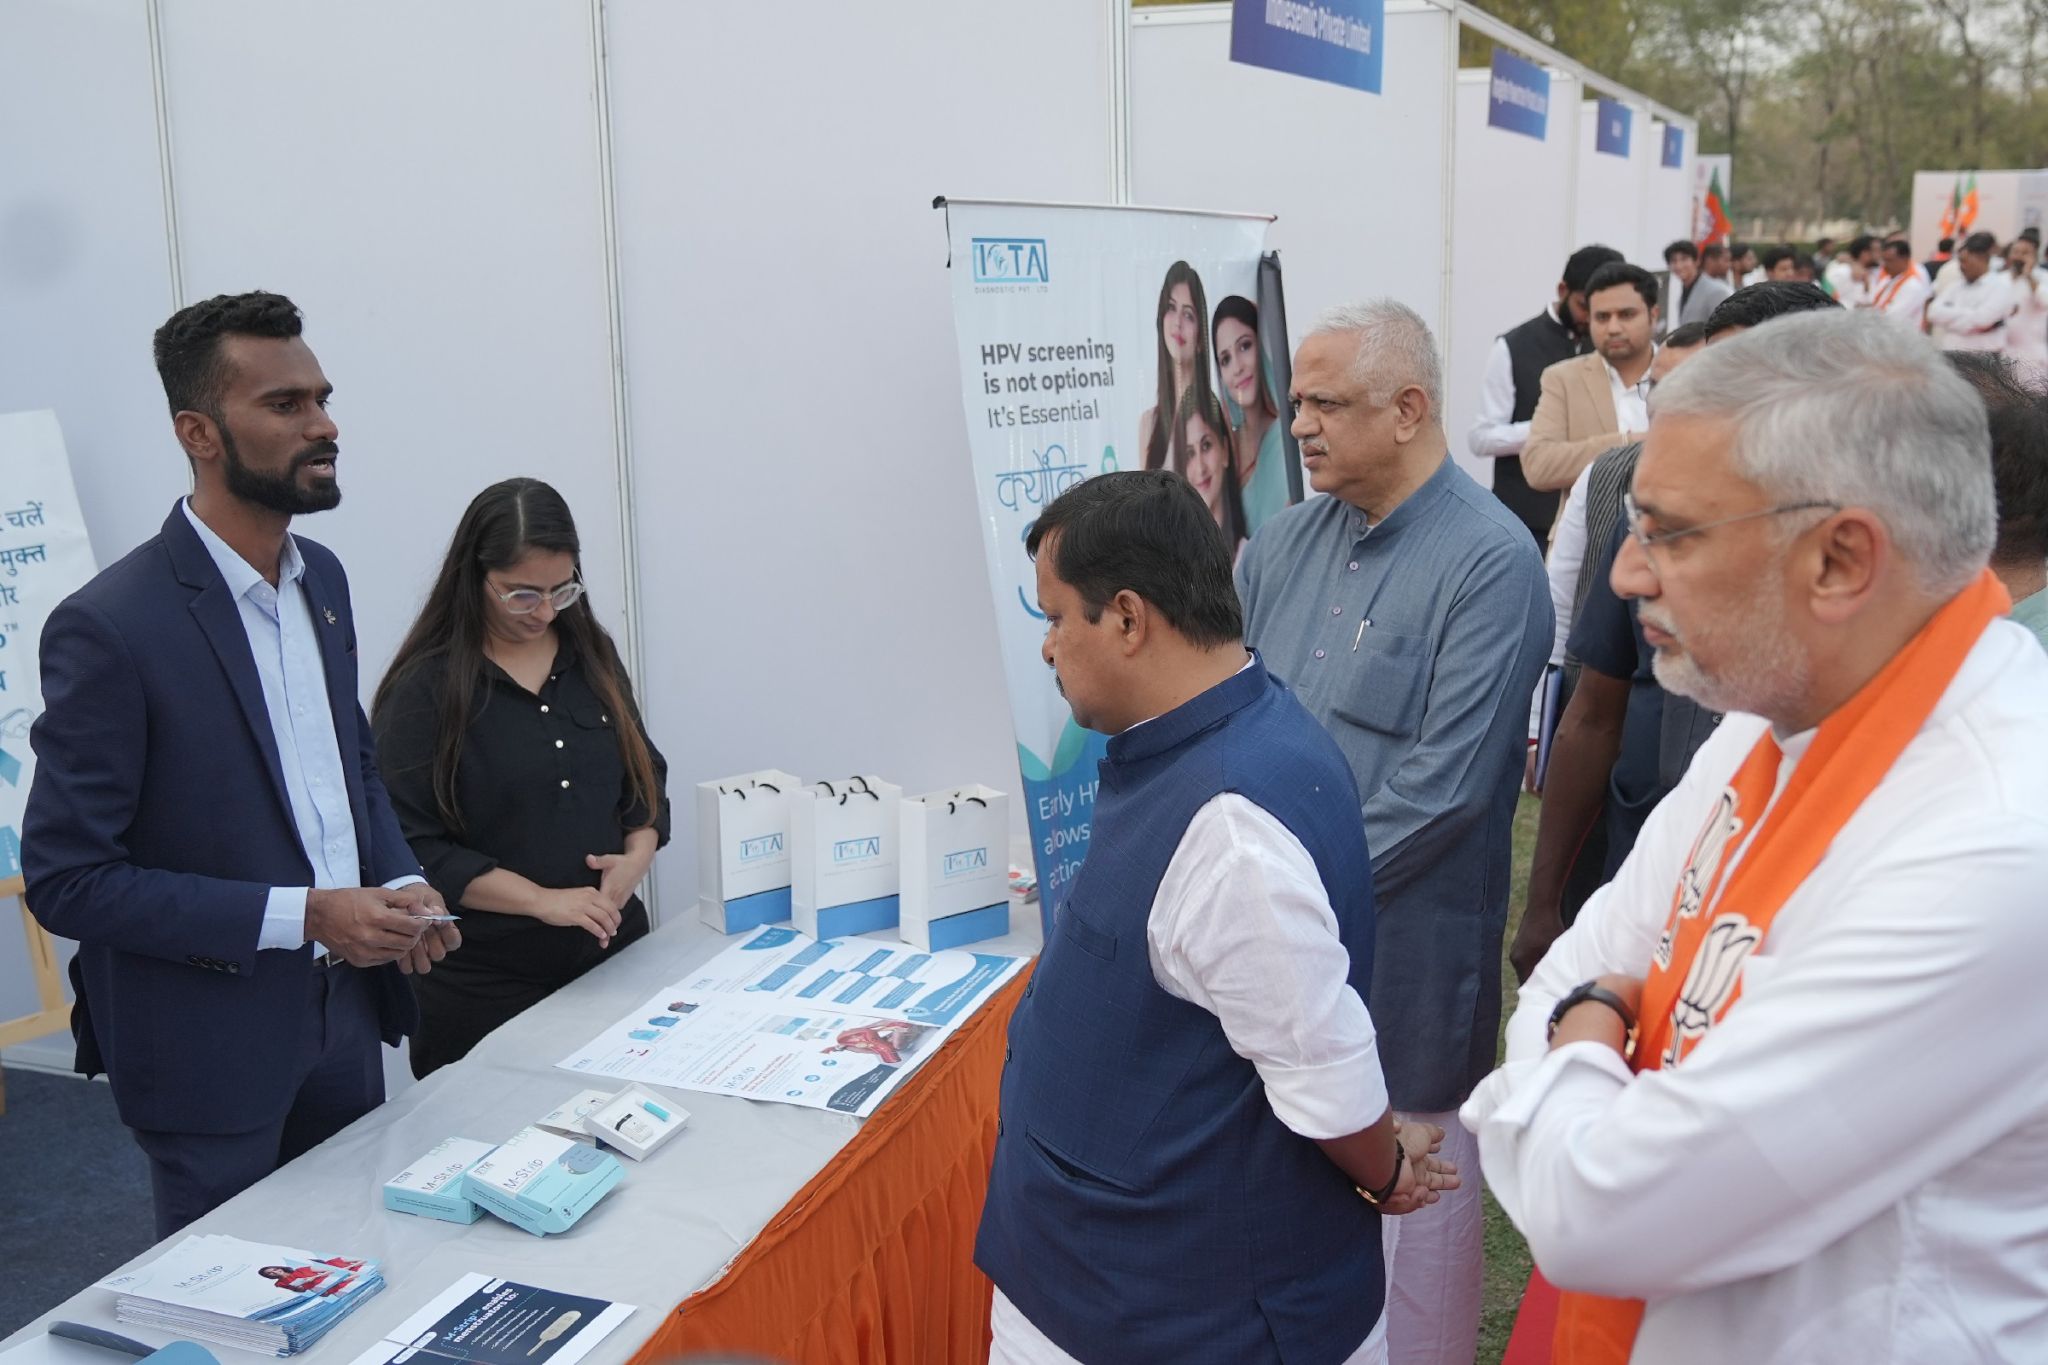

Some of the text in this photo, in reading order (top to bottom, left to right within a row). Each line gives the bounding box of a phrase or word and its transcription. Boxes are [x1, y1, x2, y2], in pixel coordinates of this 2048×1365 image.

[973, 238, 1049, 282] IOTA
[981, 338, 1114, 365] HPV screening
[984, 366, 1114, 394] is not optional
[988, 399, 1099, 428] It's Essential
